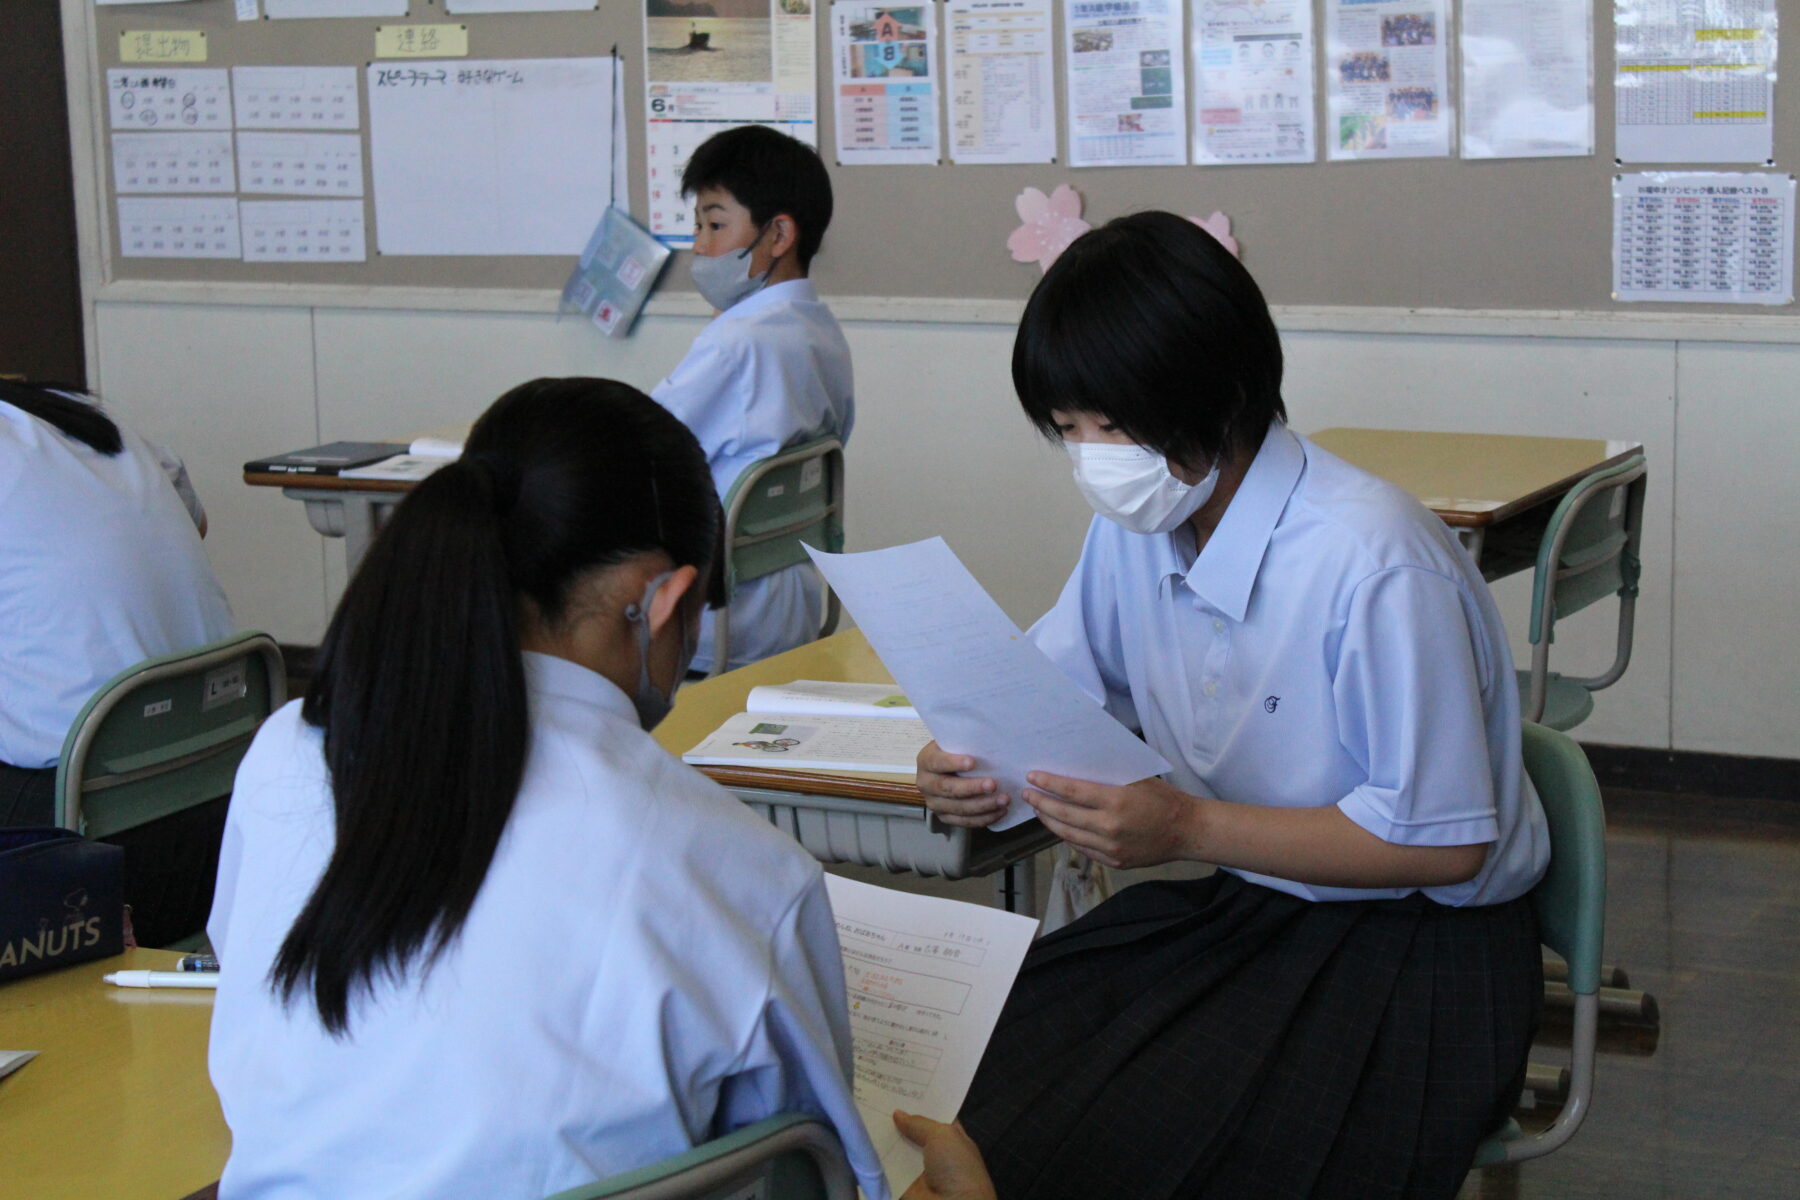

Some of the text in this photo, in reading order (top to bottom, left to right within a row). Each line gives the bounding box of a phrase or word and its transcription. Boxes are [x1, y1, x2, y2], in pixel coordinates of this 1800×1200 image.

[882, 22, 893, 38] A
[135, 33, 191, 59] 提出物
[883, 46, 895, 61] B
